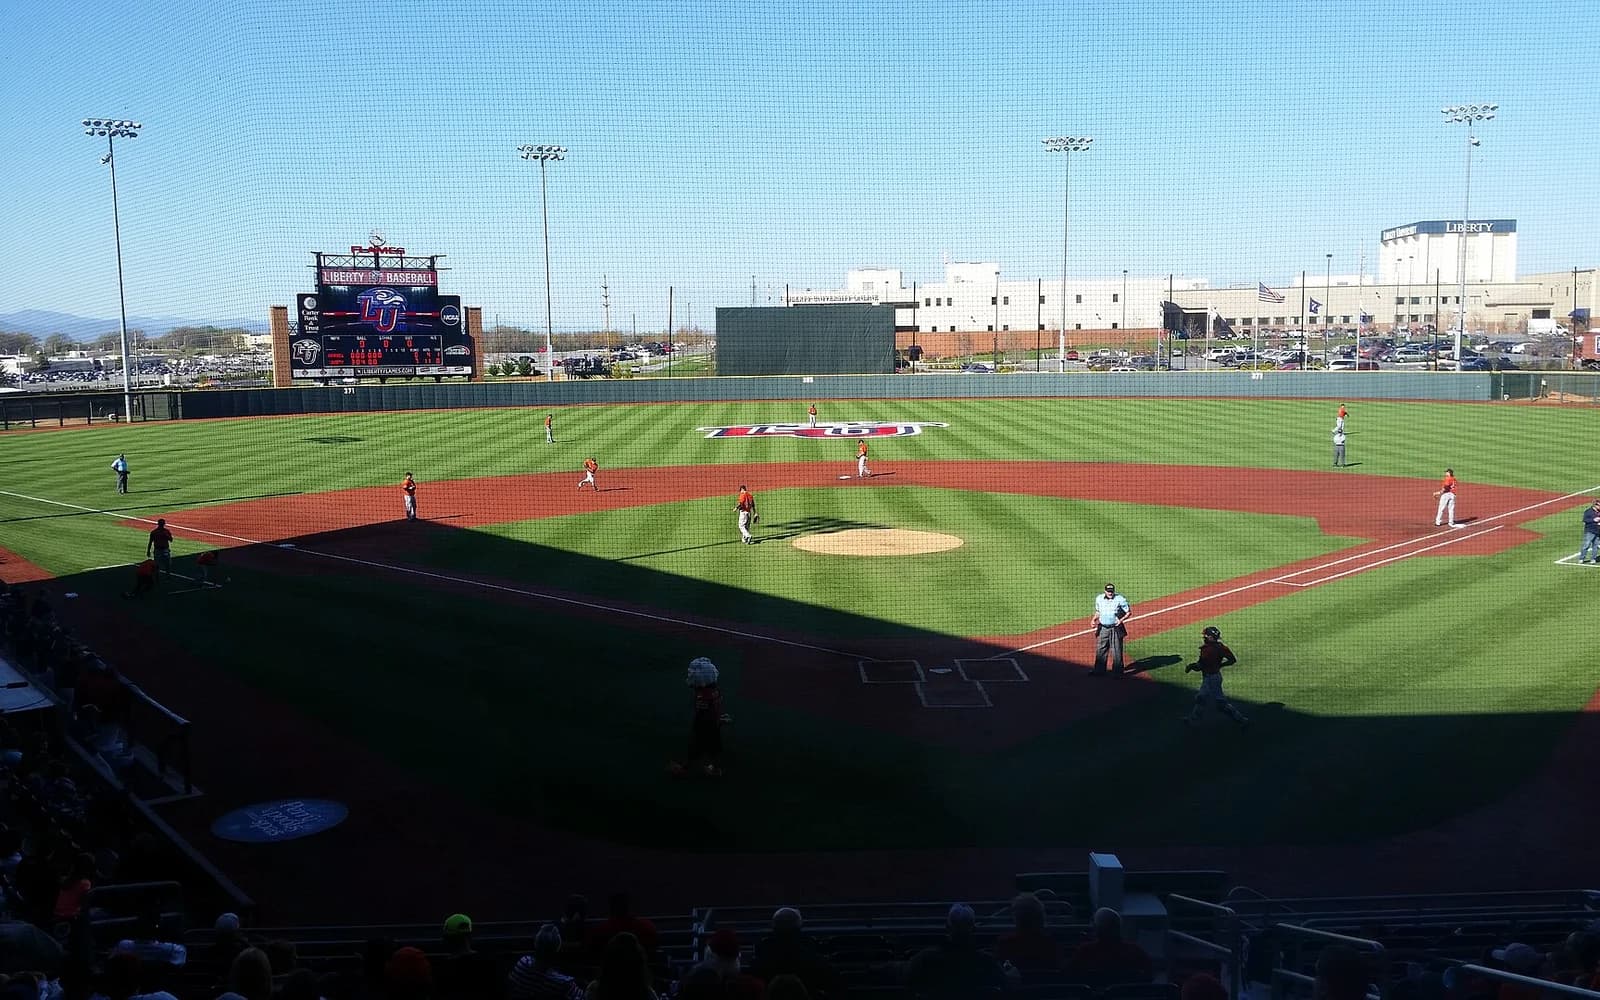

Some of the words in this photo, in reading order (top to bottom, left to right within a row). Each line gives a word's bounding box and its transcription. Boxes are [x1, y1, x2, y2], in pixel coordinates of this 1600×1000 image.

[1446, 222, 1494, 232] LIBERTY
[351, 246, 405, 254] FLAMES
[323, 271, 364, 283] LIBERTY
[386, 272, 434, 284] BASEBALL
